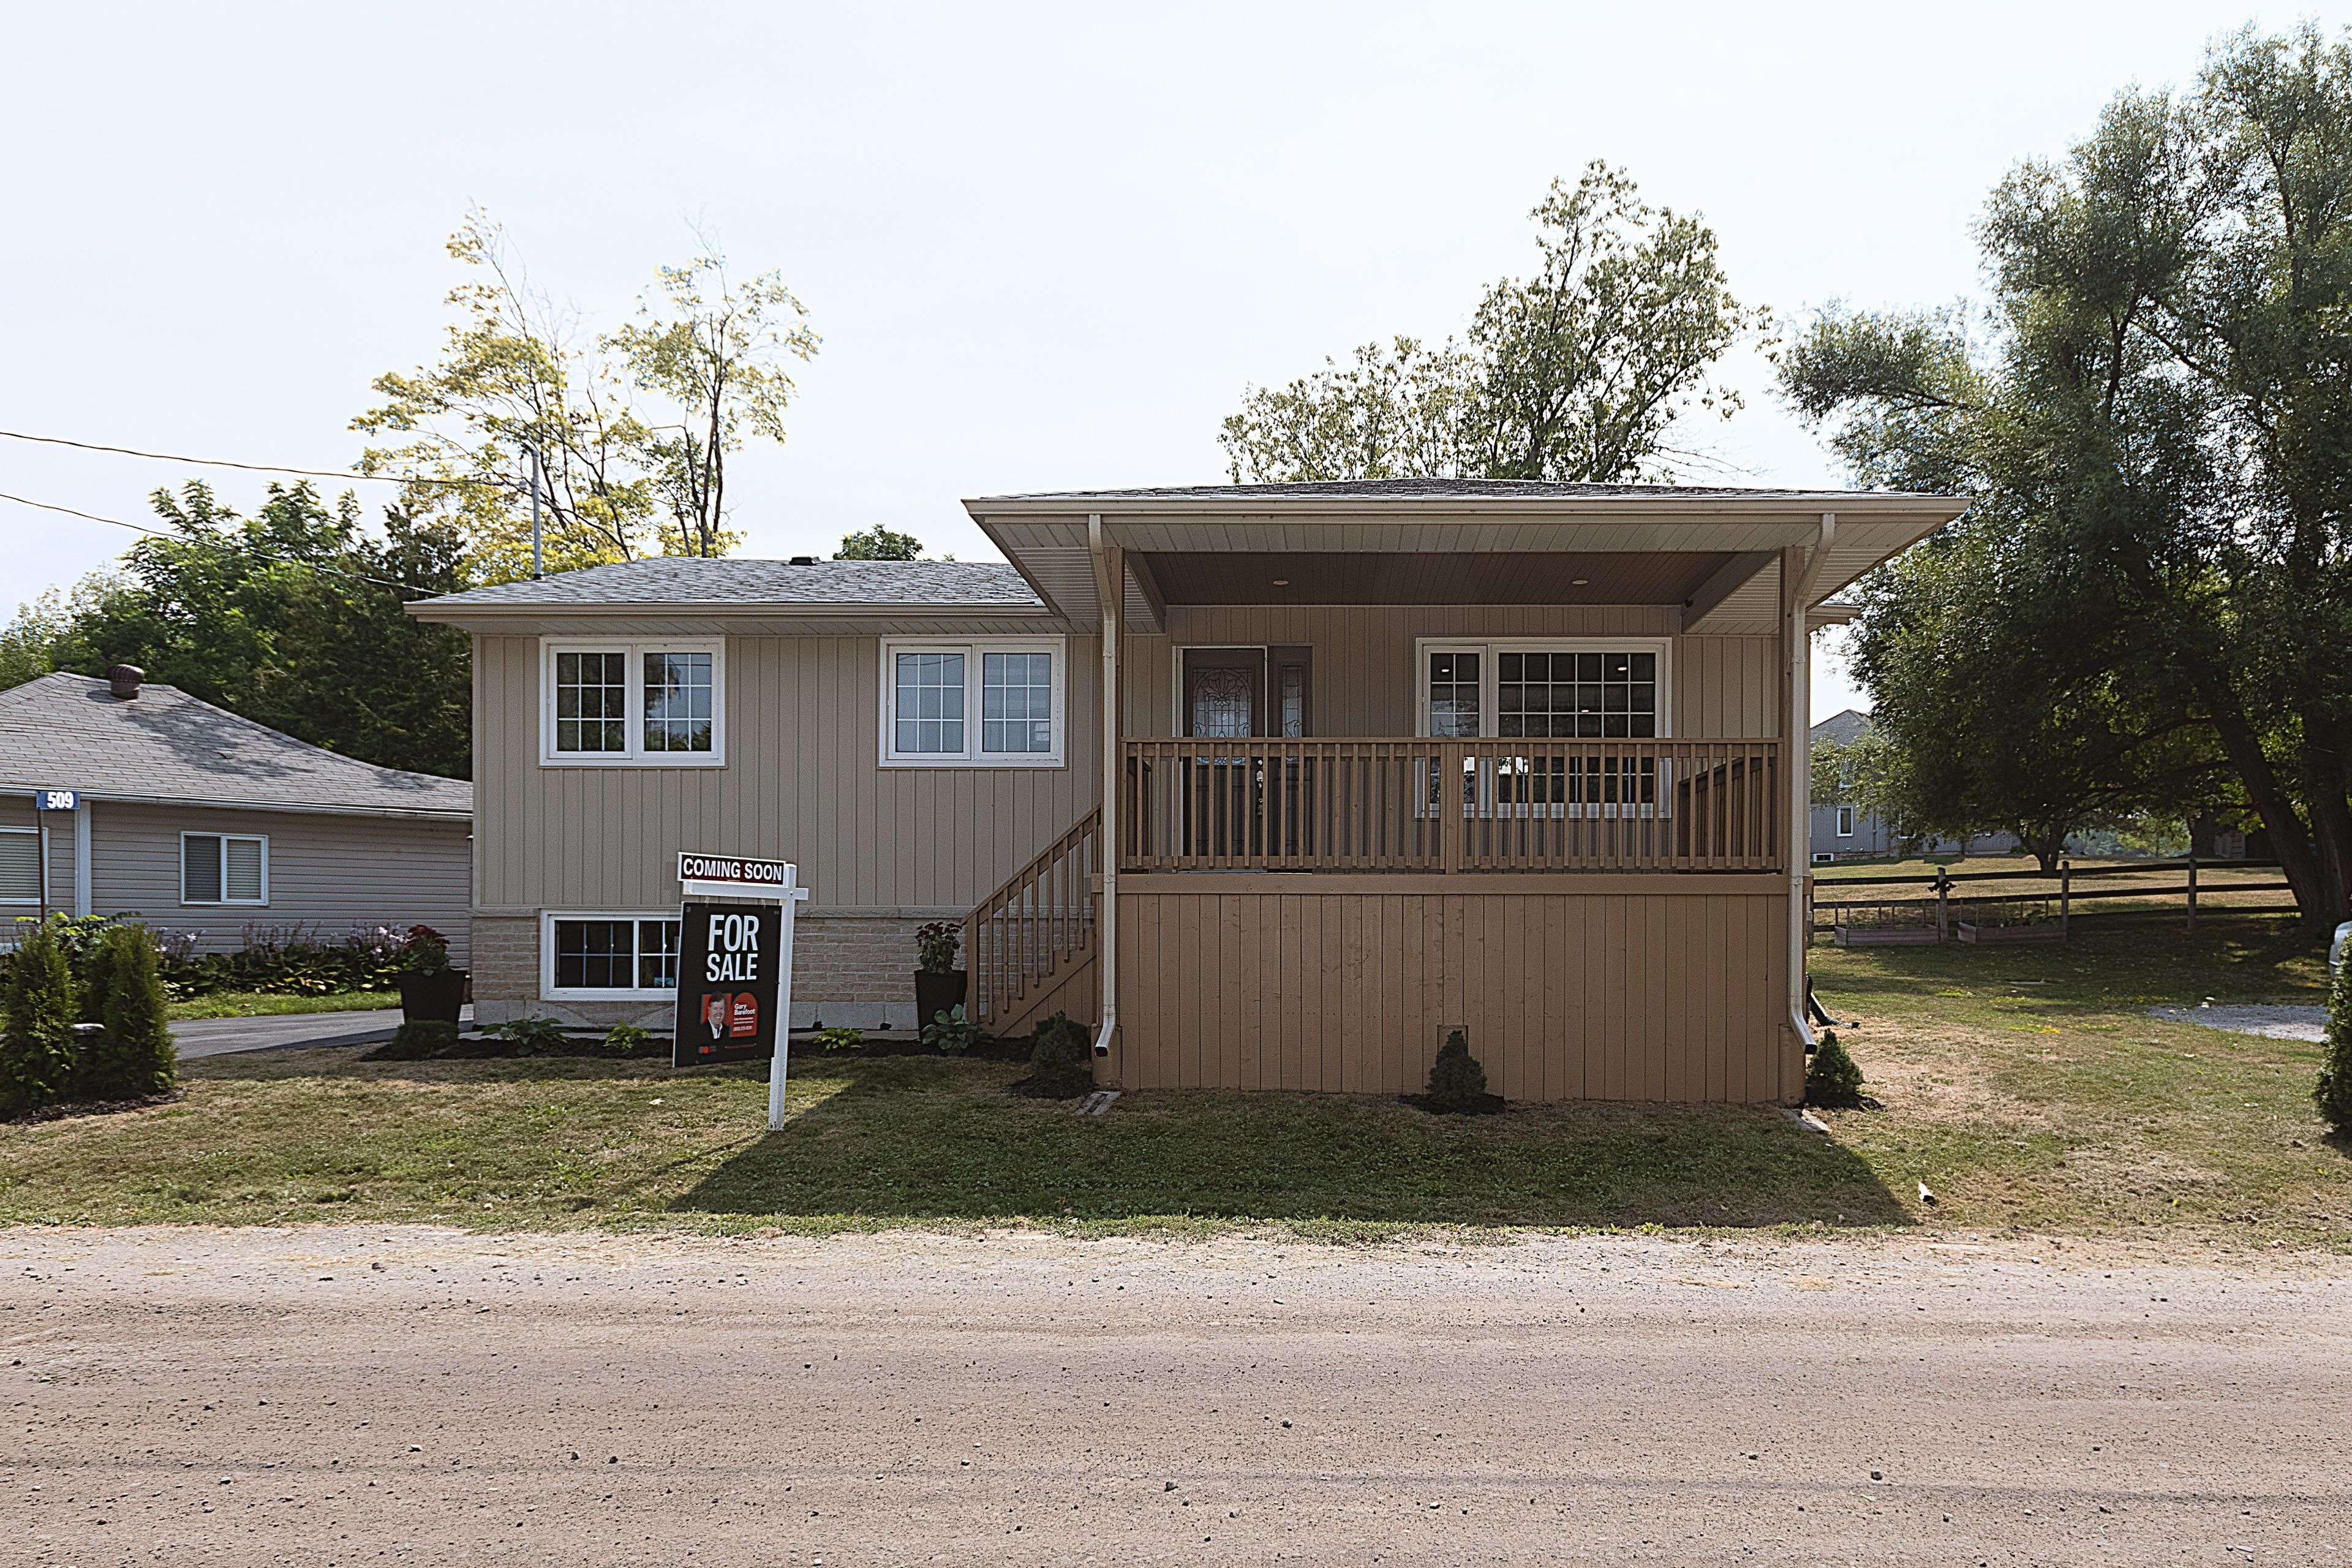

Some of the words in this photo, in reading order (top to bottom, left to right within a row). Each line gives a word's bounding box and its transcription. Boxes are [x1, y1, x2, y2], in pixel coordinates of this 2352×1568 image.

[47, 791, 74, 809] 509
[683, 858, 741, 878] COMING
[744, 862, 782, 881] SOON
[708, 914, 760, 952] FOR
[706, 953, 758, 982] SALE
